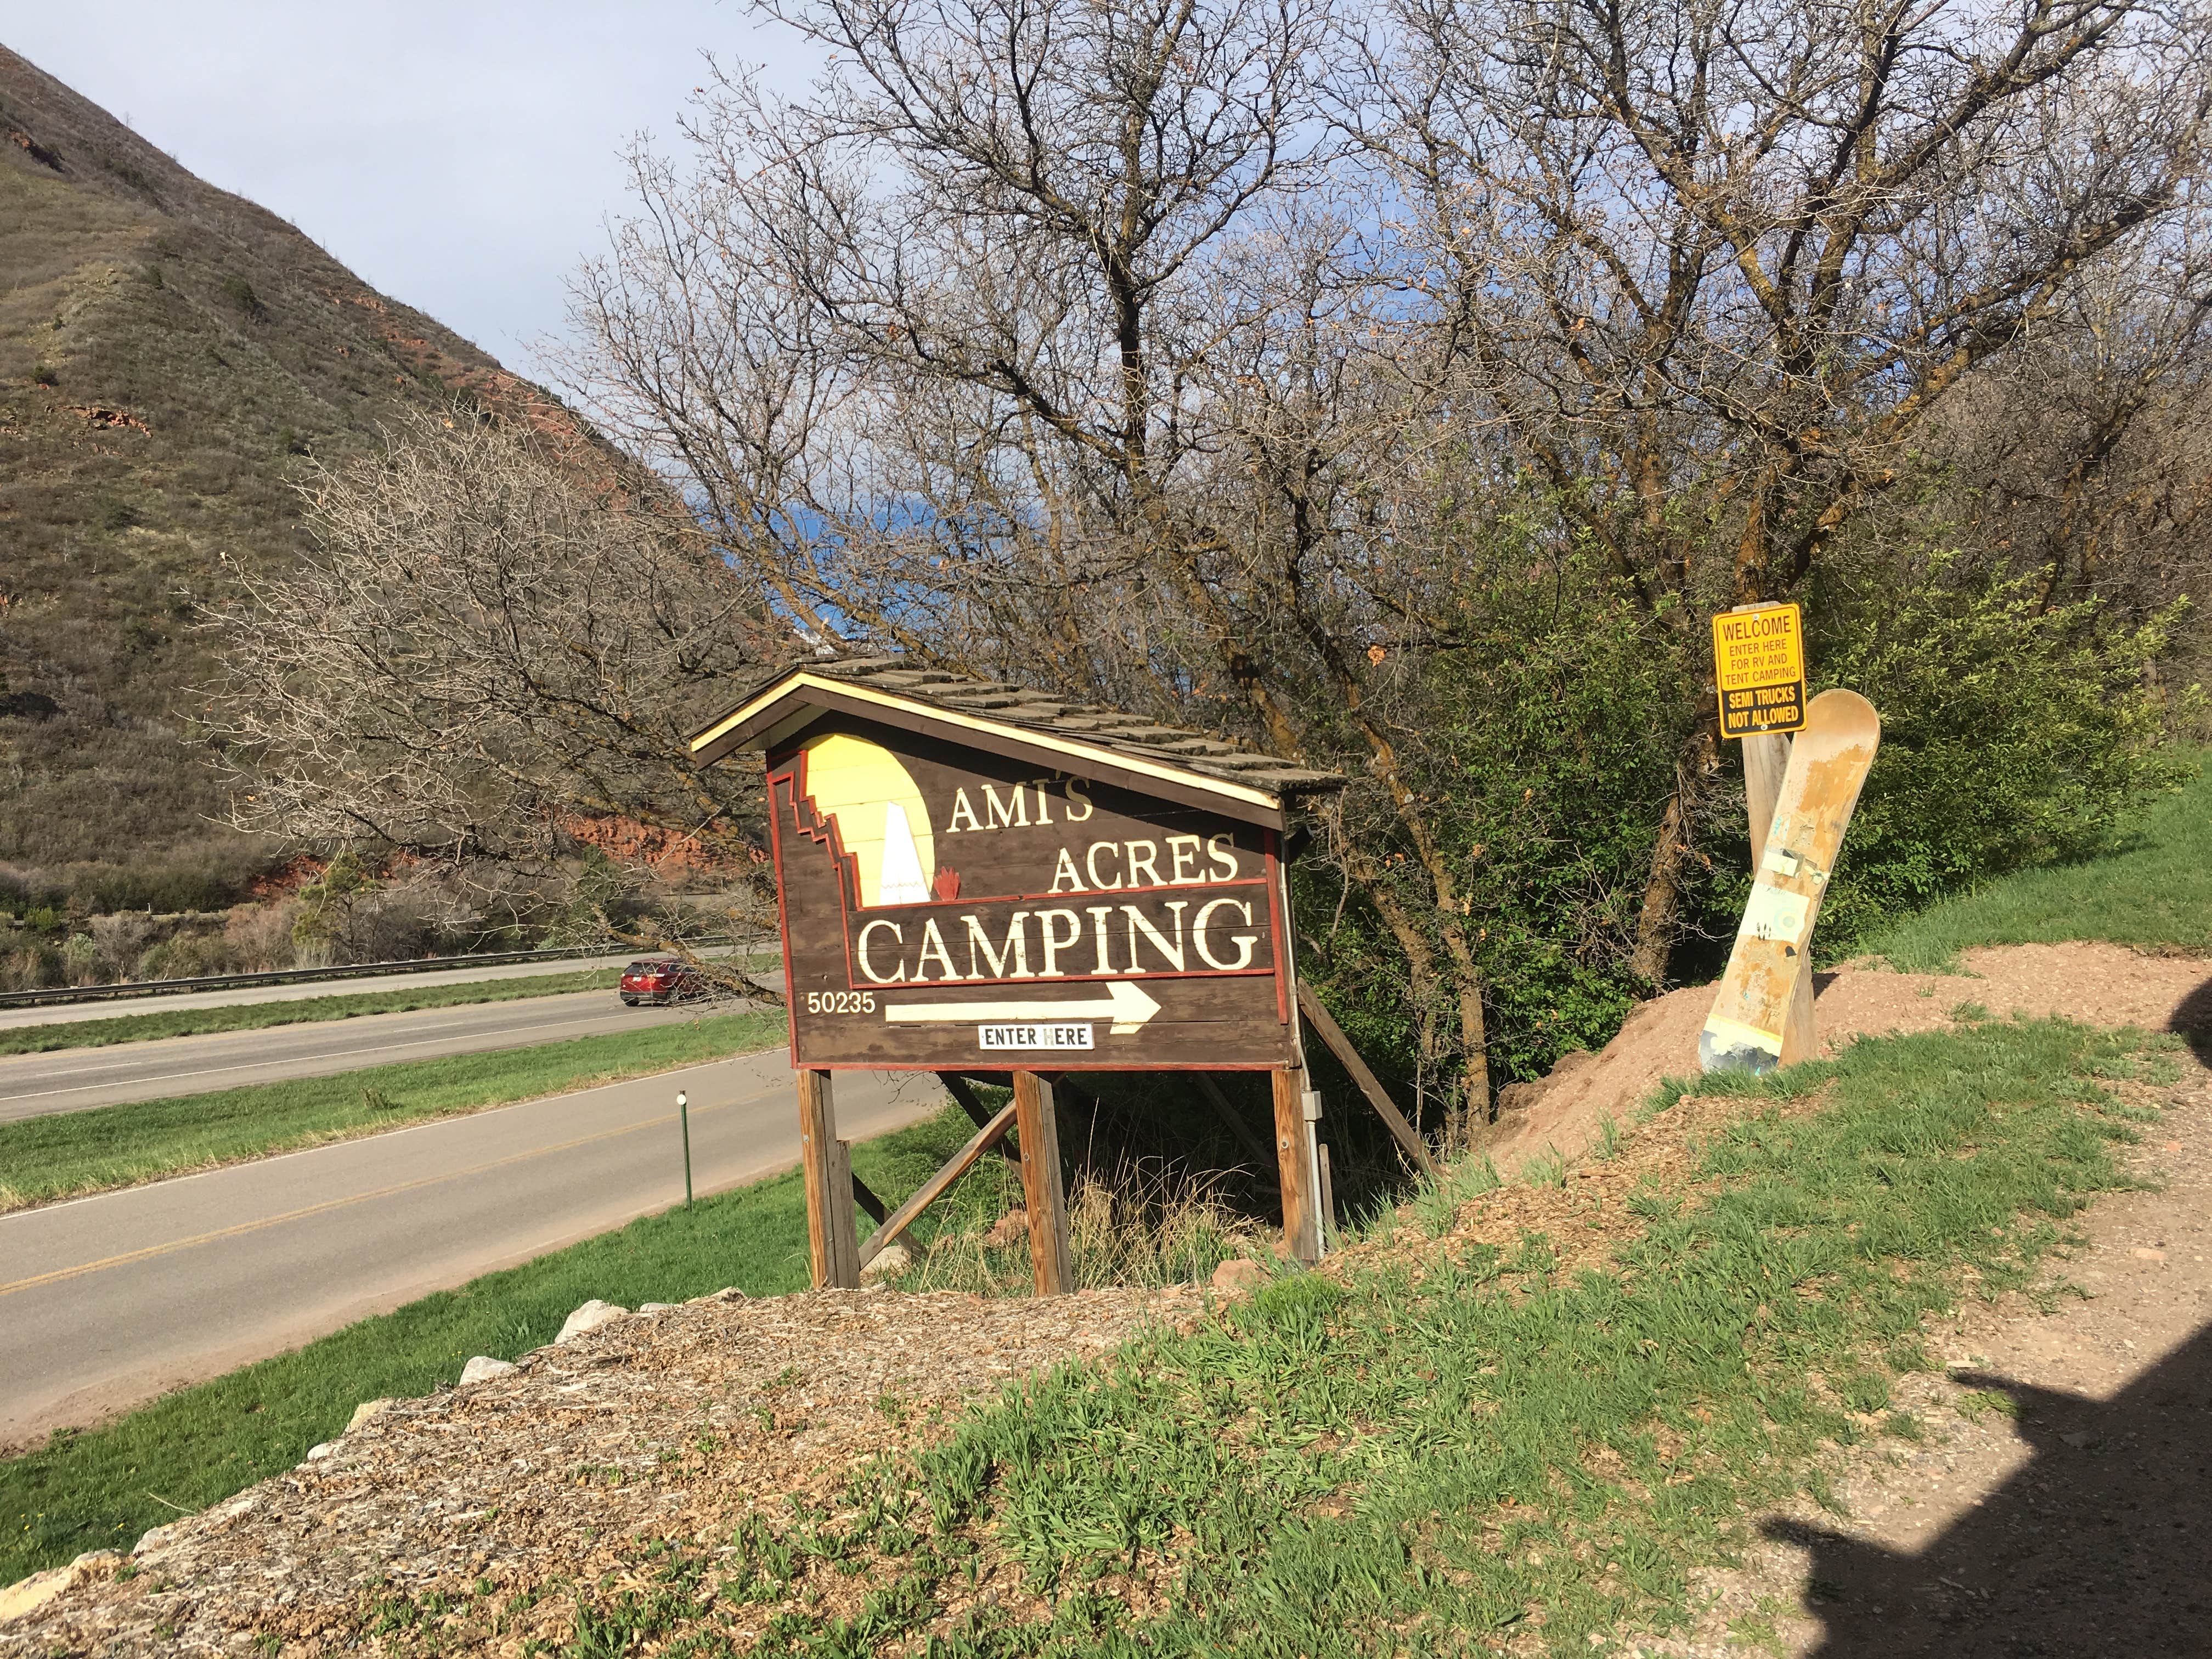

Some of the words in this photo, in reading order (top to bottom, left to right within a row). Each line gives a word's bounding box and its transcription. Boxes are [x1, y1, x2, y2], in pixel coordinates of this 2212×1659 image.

[1723, 616, 1791, 641] WELCOME
[1729, 642, 1759, 657] ENTER
[1763, 639, 1787, 651] HERE
[1731, 658, 1750, 670] FOR
[1753, 656, 1765, 667] RV
[1768, 653, 1787, 666] AND
[1725, 673, 1749, 685] TENT
[1752, 666, 1796, 682] CAMPING
[1729, 690, 1754, 709] SEMI
[1755, 686, 1796, 706] TRUCKS
[1728, 711, 1750, 729] NOT
[1752, 706, 1799, 726] ALLOWED
[946, 770, 1093, 833] AMI'S
[1047, 833, 1238, 893] ACRES
[857, 898, 1258, 984] CAMPING
[808, 991, 876, 1014] 50235
[985, 1028, 1037, 1046] ENTER
[1043, 1028, 1088, 1046] HERE
